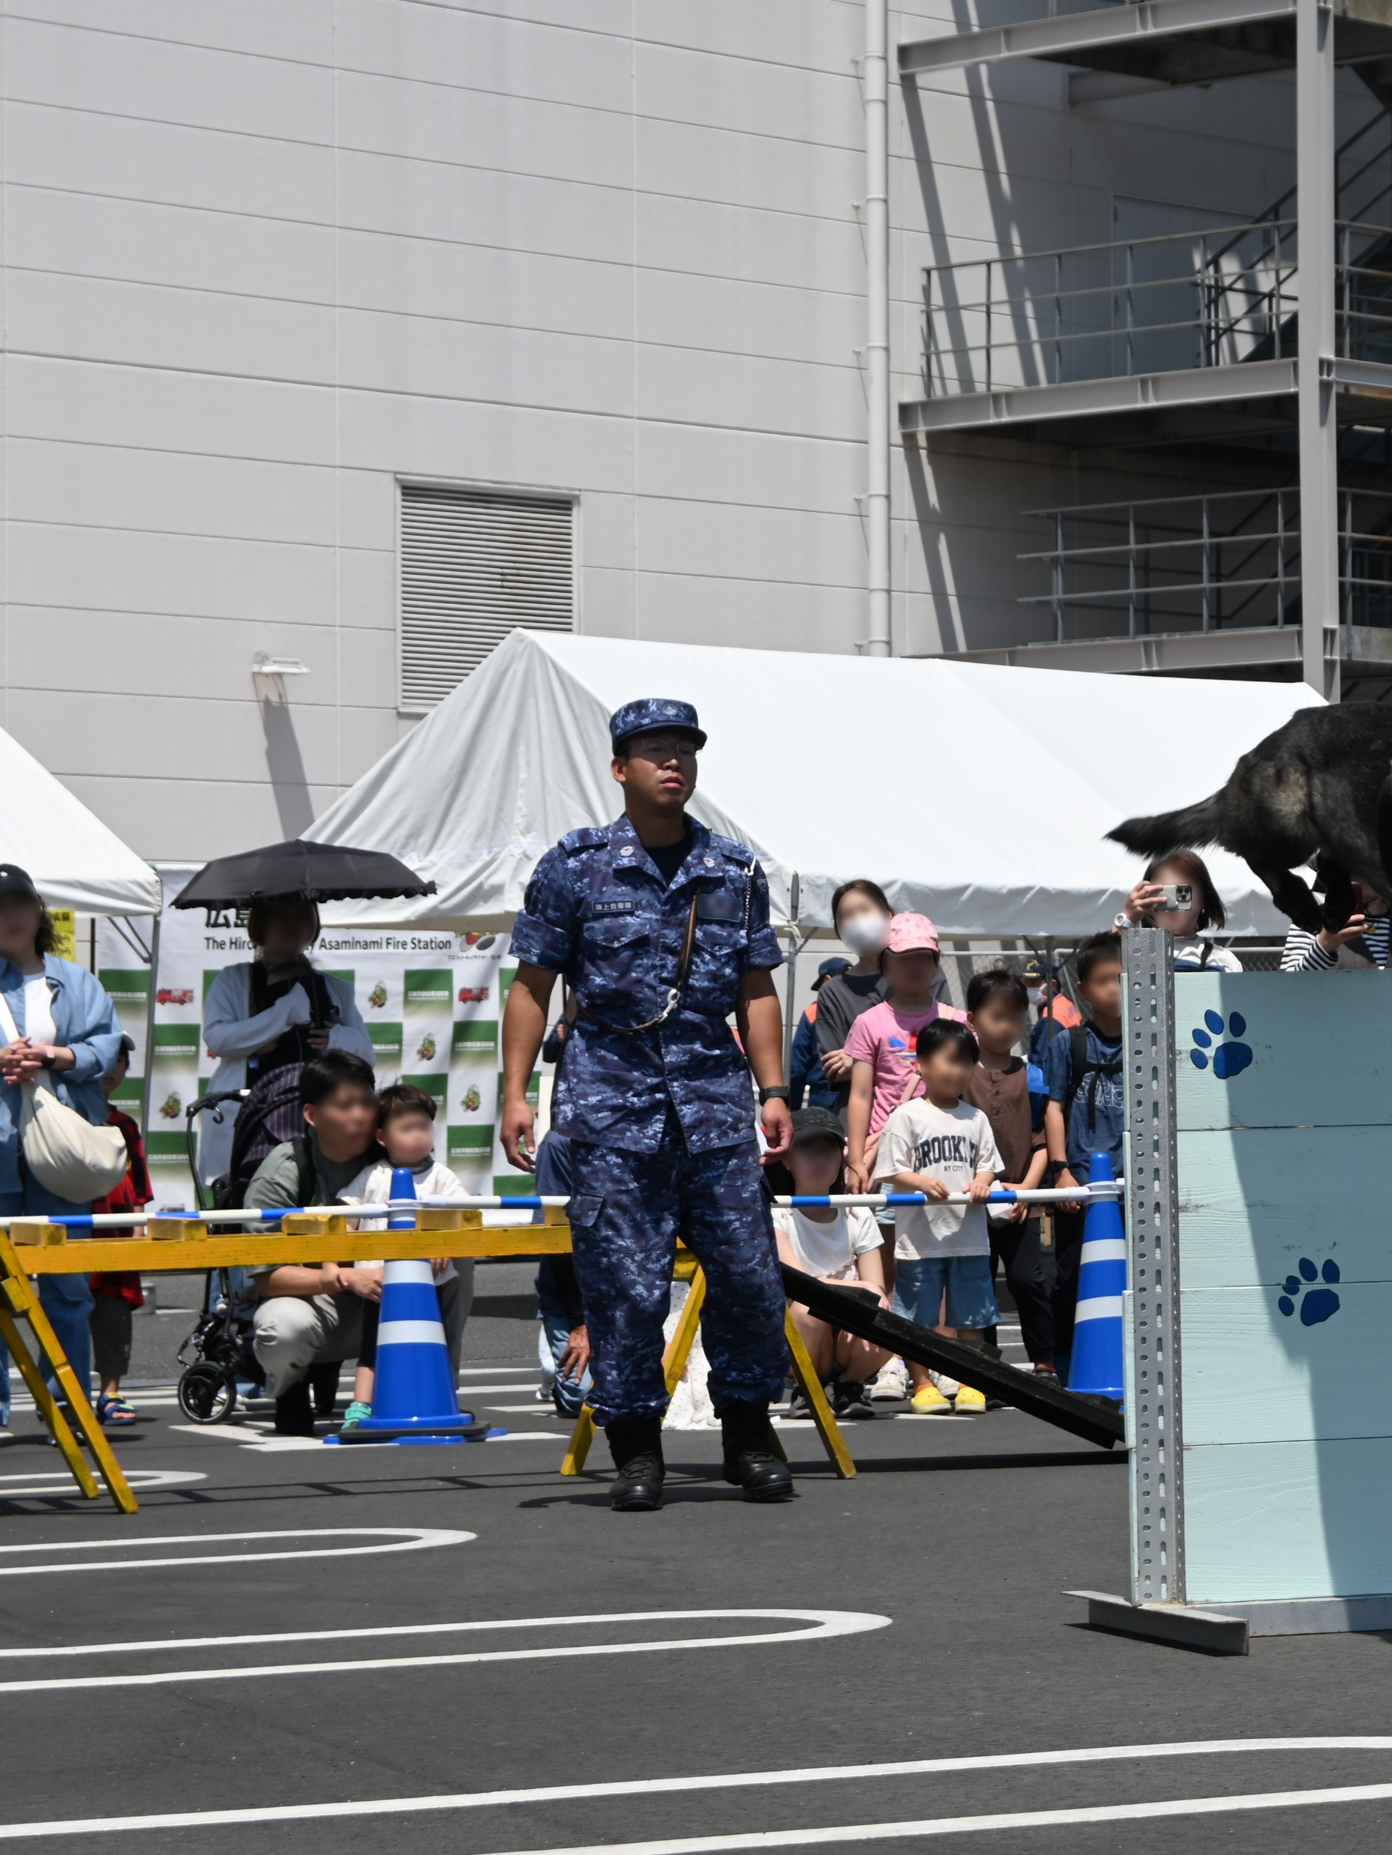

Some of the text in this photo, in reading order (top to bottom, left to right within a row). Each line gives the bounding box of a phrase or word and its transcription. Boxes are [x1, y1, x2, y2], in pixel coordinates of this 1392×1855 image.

[204, 936, 226, 950] The
[319, 936, 384, 951] Asaminami
[386, 936, 408, 950] Fire
[410, 936, 452, 950] Station
